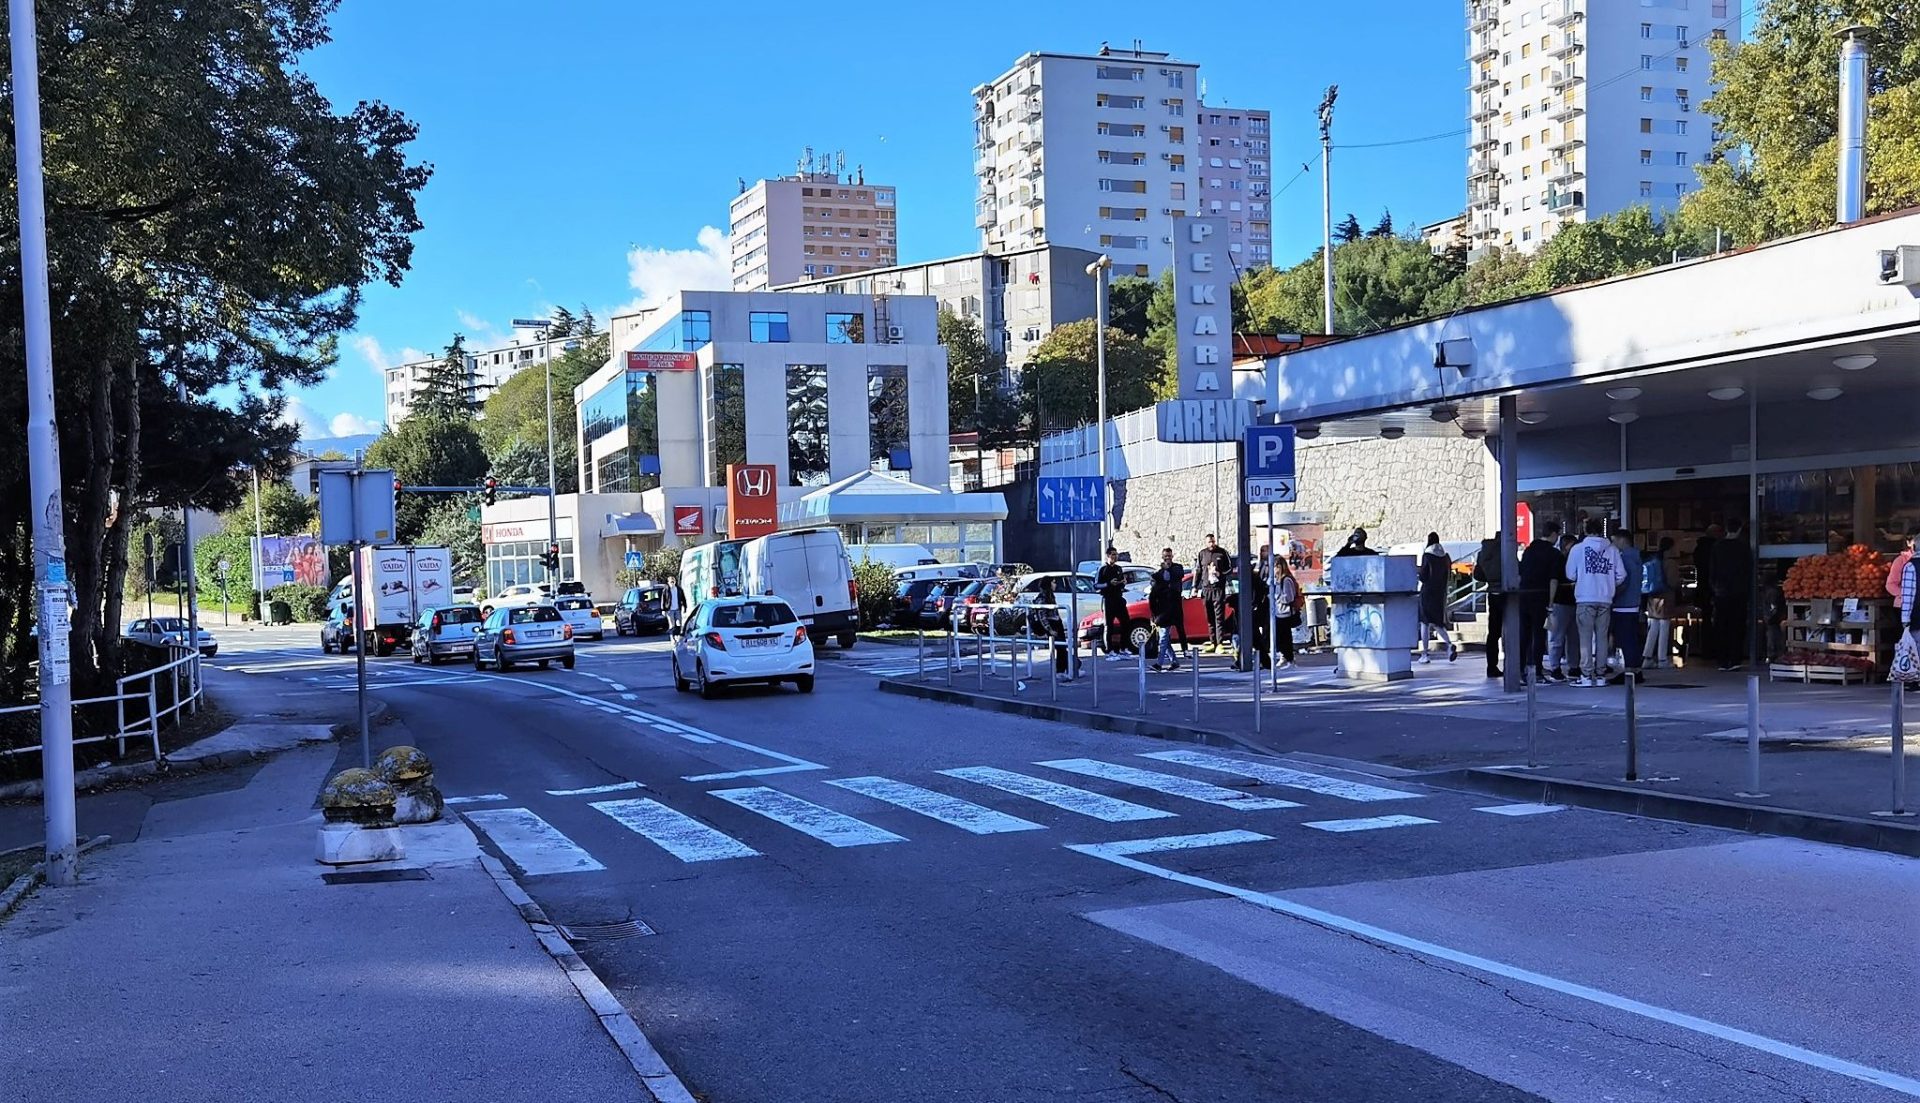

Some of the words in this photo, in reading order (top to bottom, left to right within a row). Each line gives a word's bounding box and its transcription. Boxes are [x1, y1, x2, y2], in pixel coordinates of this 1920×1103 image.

[1190, 223, 1220, 391] PEKARA
[1166, 400, 1249, 441] ARENA
[1259, 435, 1283, 468] P
[1250, 485, 1261, 496] 10
[1264, 487, 1272, 496] m
[496, 528, 524, 537] HONDA
